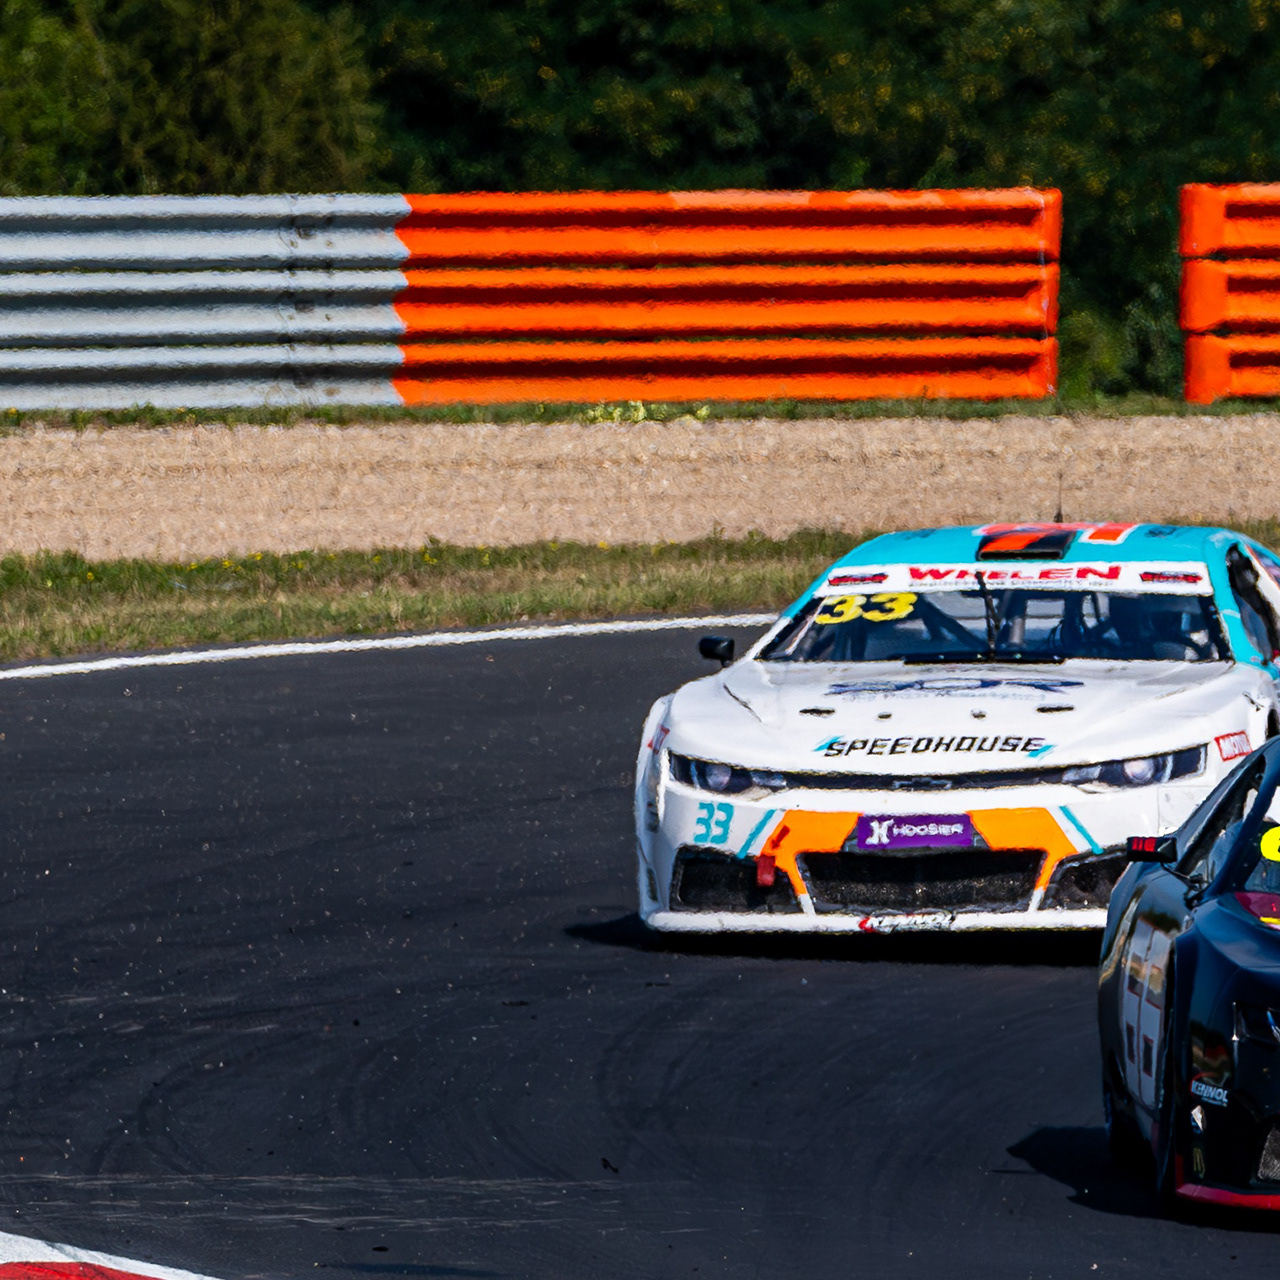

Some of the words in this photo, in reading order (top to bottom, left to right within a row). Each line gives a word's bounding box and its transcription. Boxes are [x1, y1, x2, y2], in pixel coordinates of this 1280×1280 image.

[908, 566, 1121, 581] WHELEN
[815, 591, 918, 624] 33
[824, 736, 1046, 758] SPEEDHOUSE
[695, 802, 734, 844] 33
